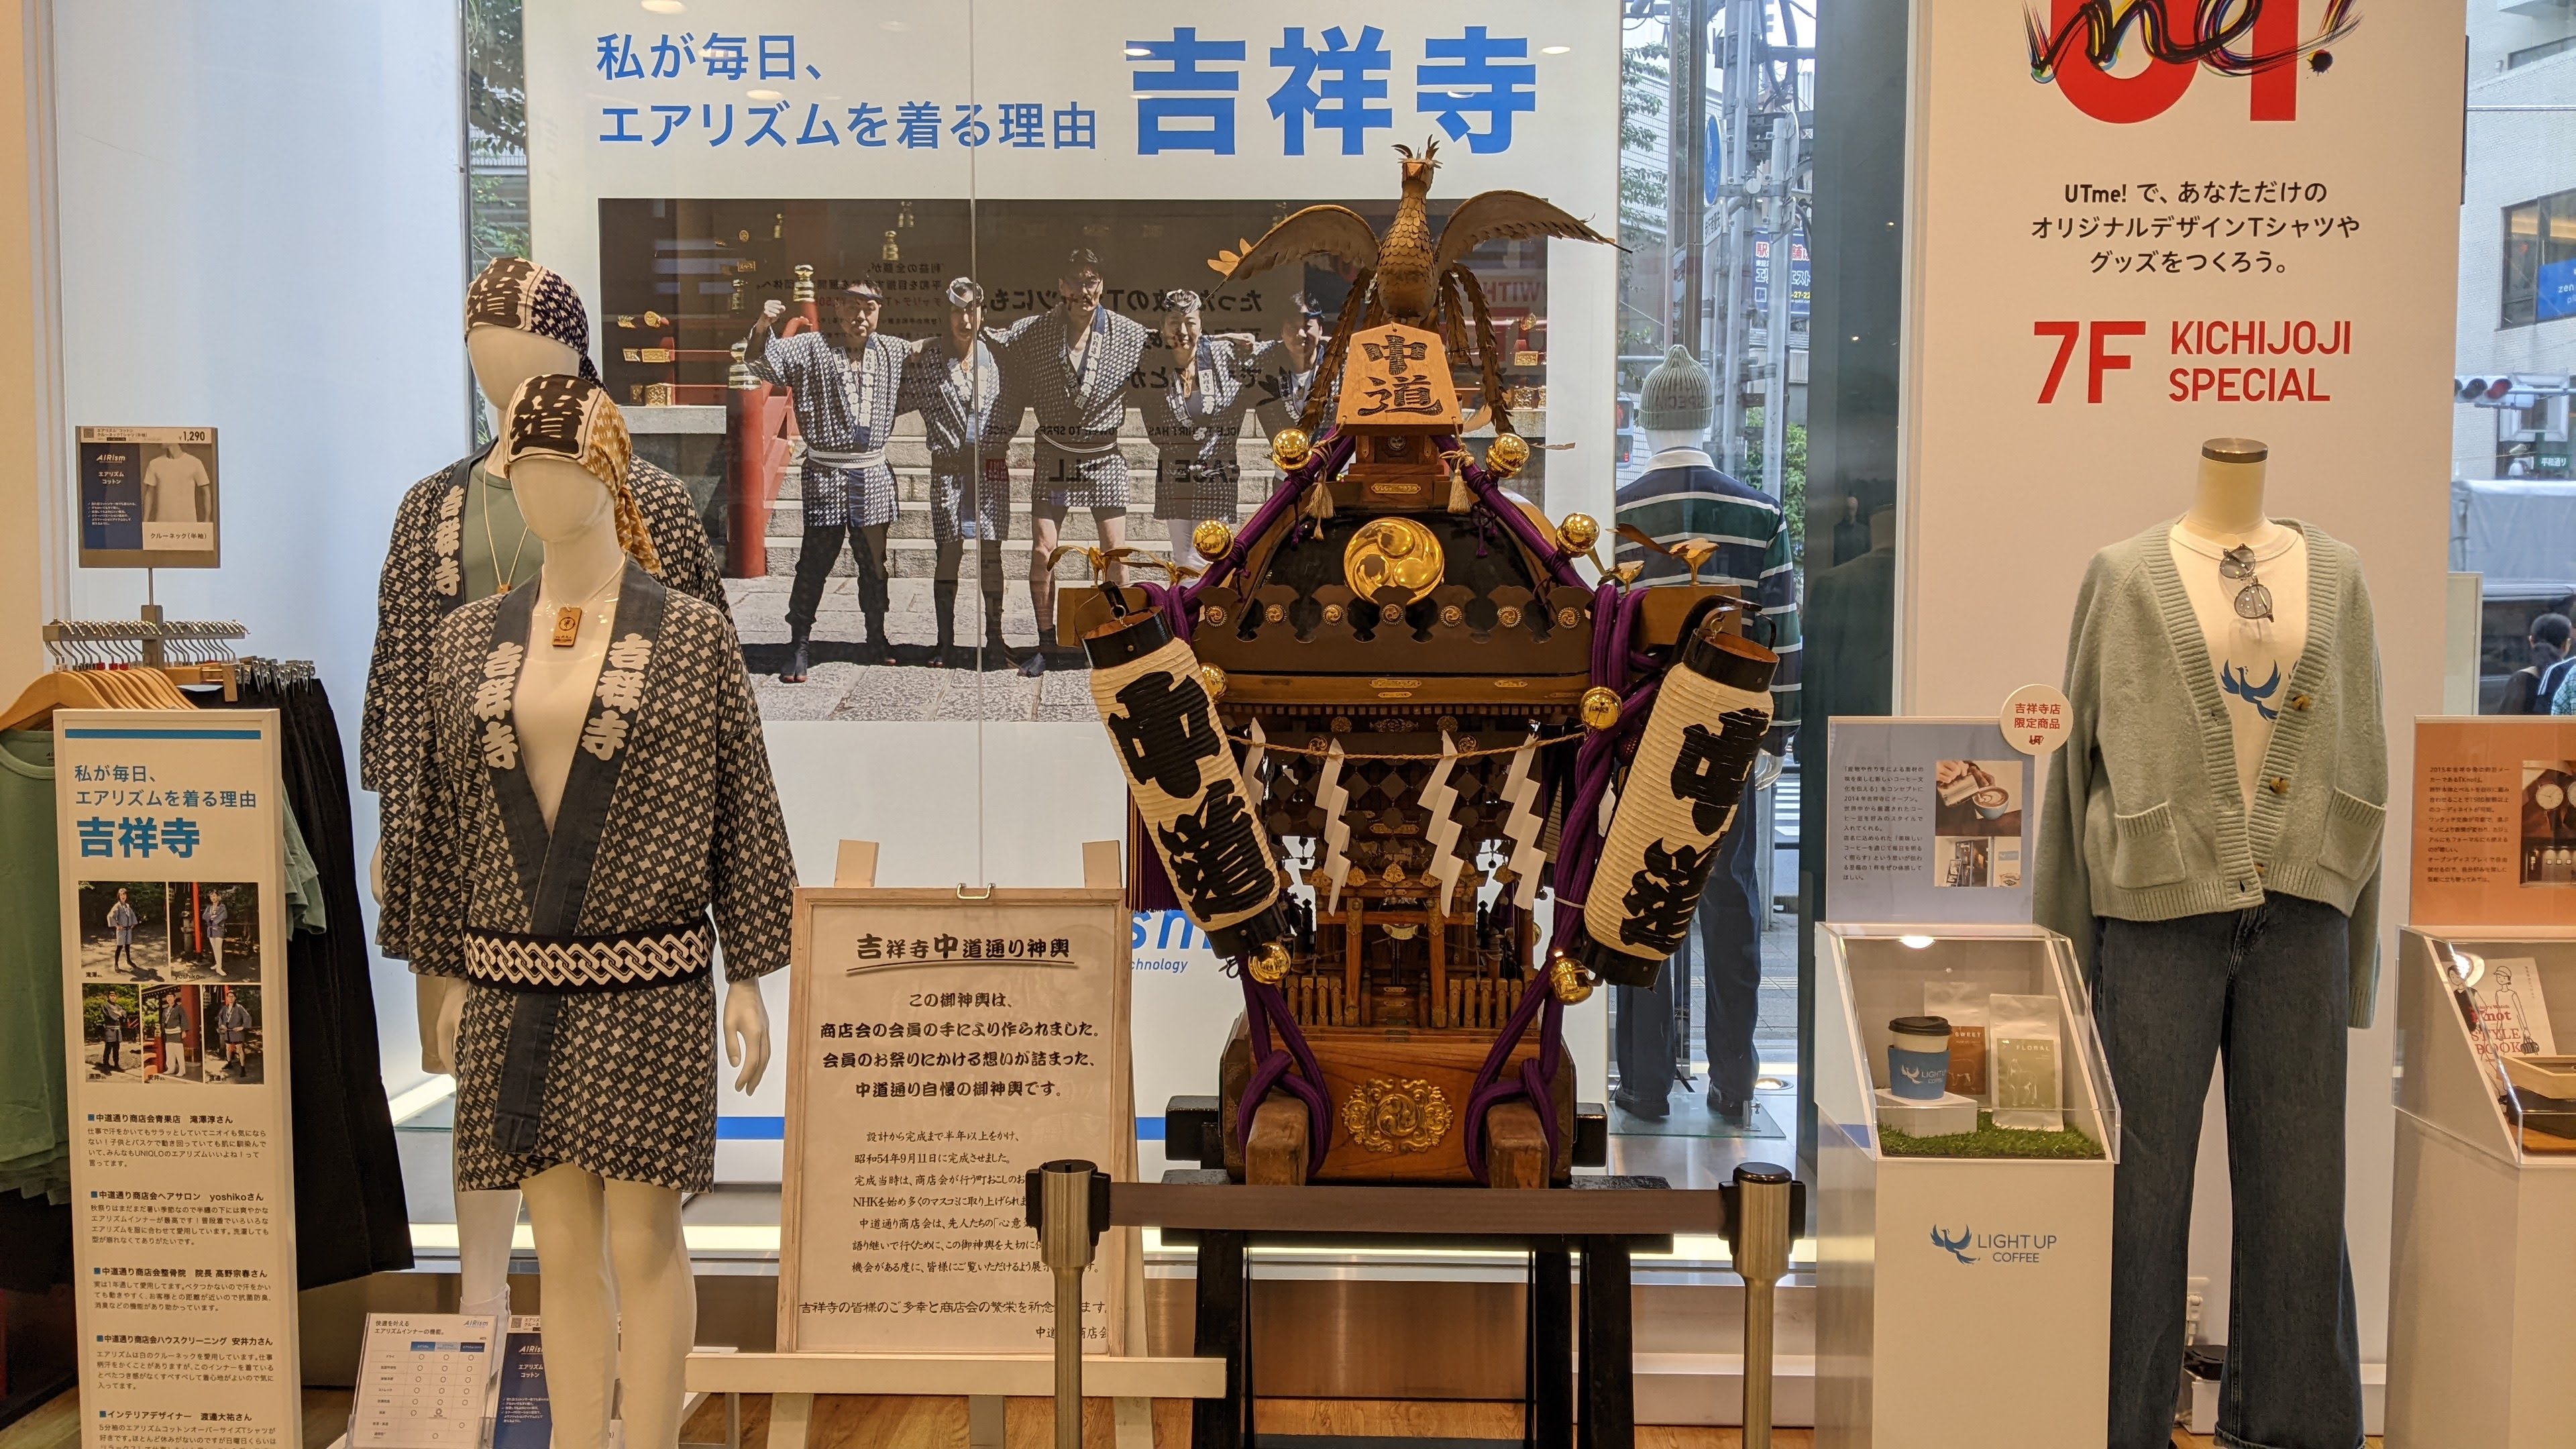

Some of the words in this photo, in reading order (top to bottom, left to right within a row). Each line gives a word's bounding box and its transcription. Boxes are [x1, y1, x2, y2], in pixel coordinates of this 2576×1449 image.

[596, 32, 821, 81] 私が毎日、
[1125, 25, 1537, 156] 吉祥寺
[599, 100, 1096, 150] エアリズムを着る理由
[2064, 183, 2127, 203] UTme!
[2136, 180, 2328, 204] で、あなただけの
[2031, 215, 2361, 239] オリジナルデザインTシャツや
[2090, 250, 2286, 274] グッズをつくろう。
[2171, 320, 2351, 355] KICHIJOJI
[2033, 321, 2147, 405] 7F
[1358, 334, 1444, 417] 中道
[2168, 368, 2331, 402] SPECIAL
[433, 485, 465, 596] 吉祥寺
[474, 642, 524, 771] 吉祥寺
[581, 633, 653, 761] 吉祥寺
[2015, 703, 2061, 714] 吉祥寺店
[2015, 718, 2060, 729] 限定商品
[74, 764, 156, 782] 私が毎日、
[76, 788, 256, 808] エアリズムを着る理由
[76, 816, 200, 859] 吉祥寺
[857, 933, 1070, 960] 吉祥寺中道通り神輿
[909, 992, 1013, 1008] この御神輿は、
[820, 1022, 1100, 1039] 商店会の会員の手により作られました。
[822, 1051, 1095, 1068] 会員のお祭りにかける想いが詰まった、
[855, 1081, 1063, 1098] 中道通り自慢の御神輿です。
[865, 1130, 1020, 1143] 設計から完成まで半年以上をかけ、
[854, 1152, 1011, 1165] 昭和54年9月11日に完成させました。
[209, 1193, 264, 1202] yoshikoさん
[1978, 1234, 2030, 1249] LIGHT
[2034, 1235, 2057, 1249] UP
[1992, 1252, 2039, 1263] COFFEE
[107, 1411, 192, 1420] インテリアデザイナー
